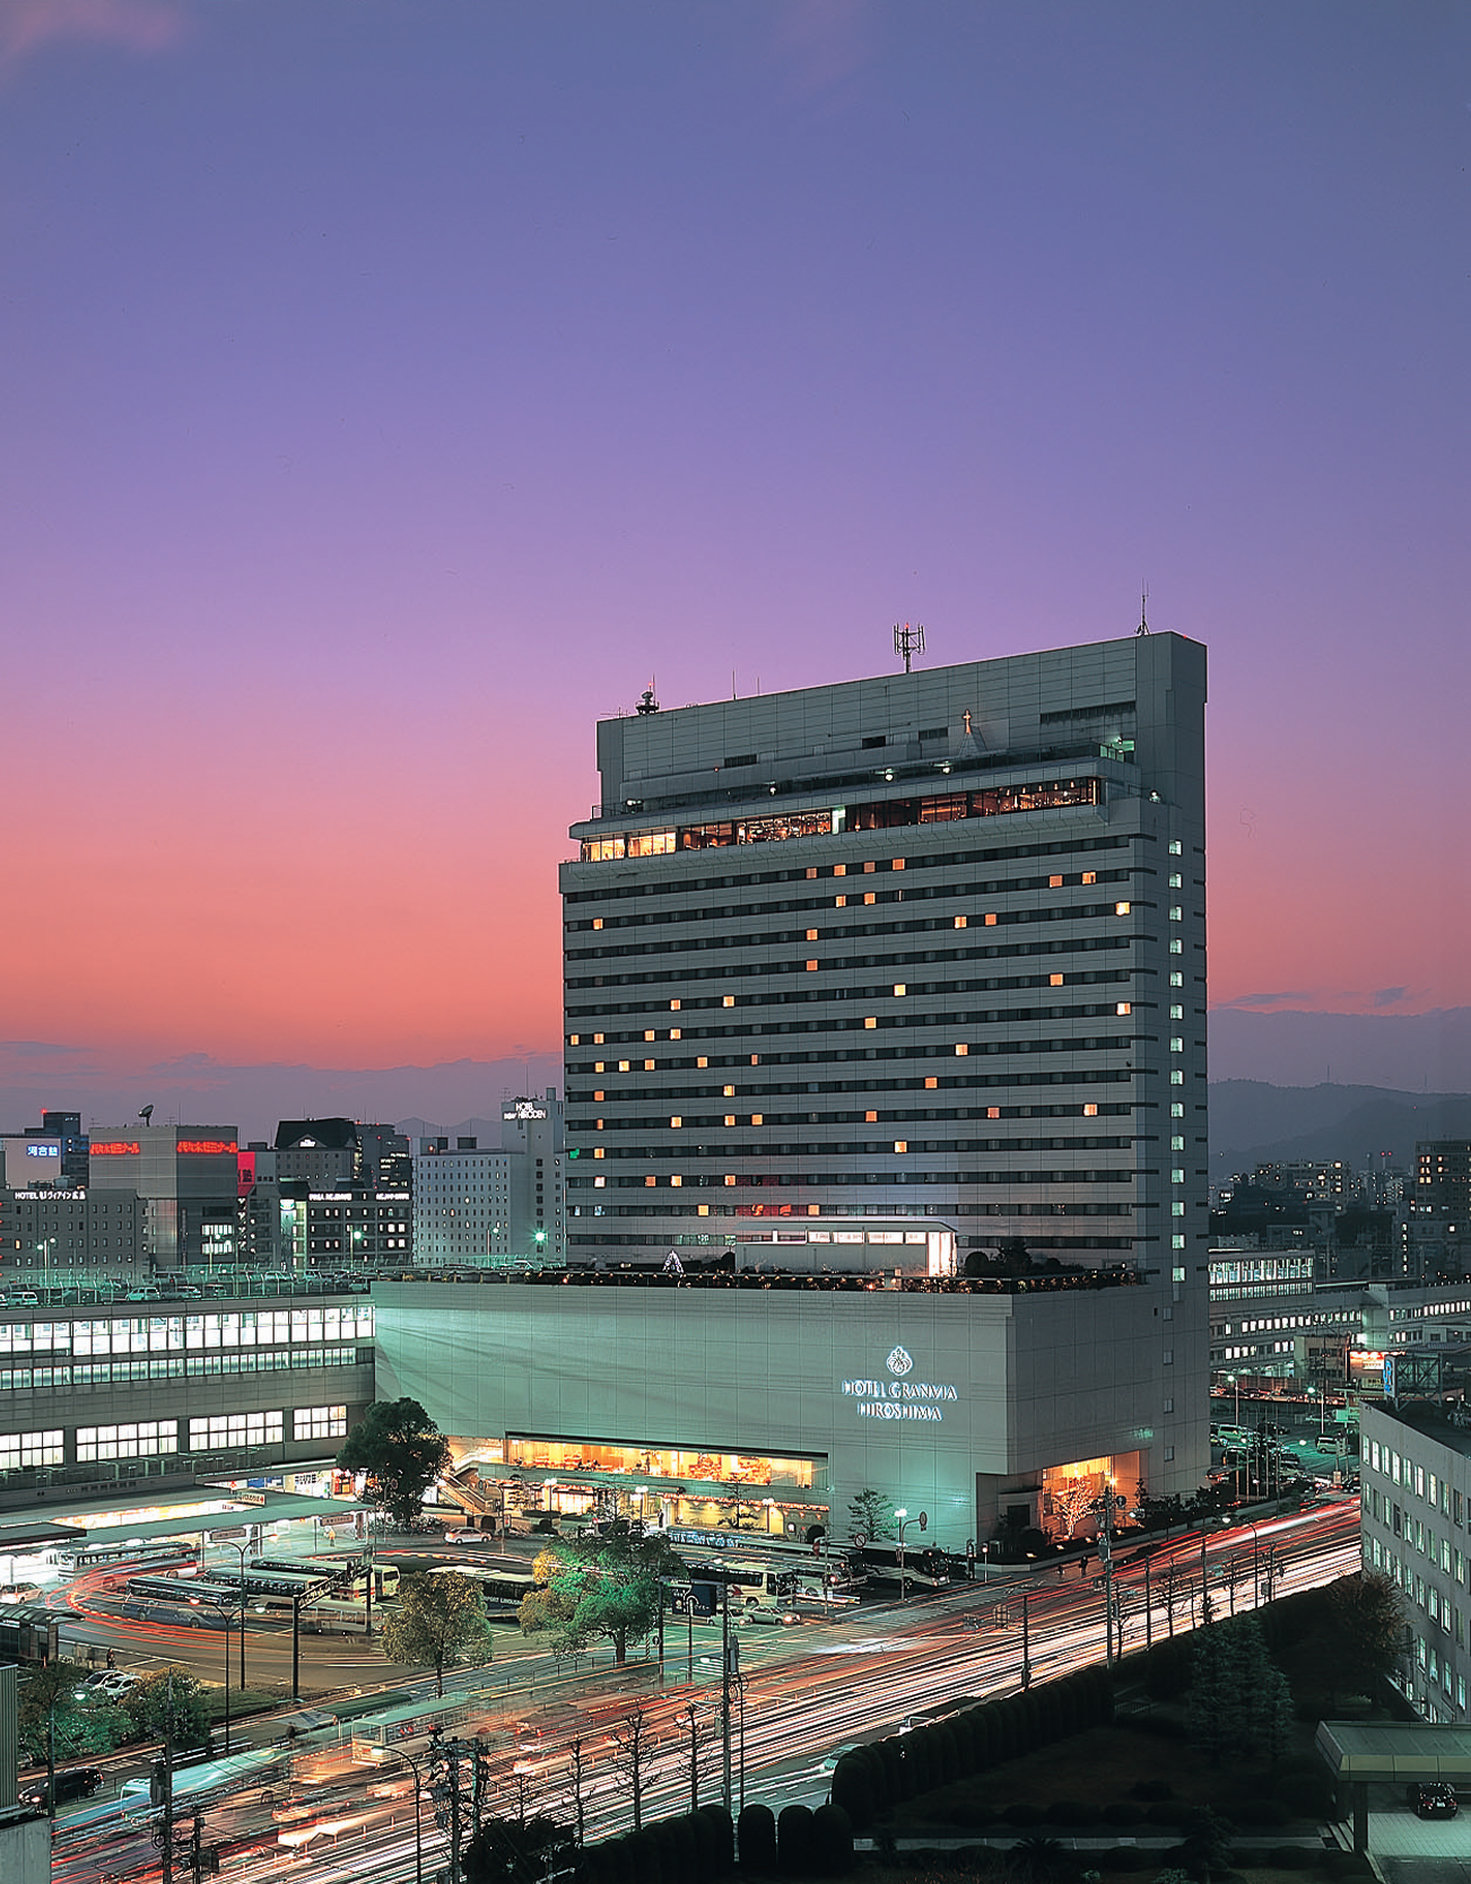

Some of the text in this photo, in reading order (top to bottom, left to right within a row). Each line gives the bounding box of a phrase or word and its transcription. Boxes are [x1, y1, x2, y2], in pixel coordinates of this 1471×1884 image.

[27, 1145, 58, 1156] 河合塾
[14, 1191, 38, 1200] HOTEL
[842, 1379, 958, 1401] HOTEL GRANVIA
[857, 1402, 943, 1421] HIROSHIMA
